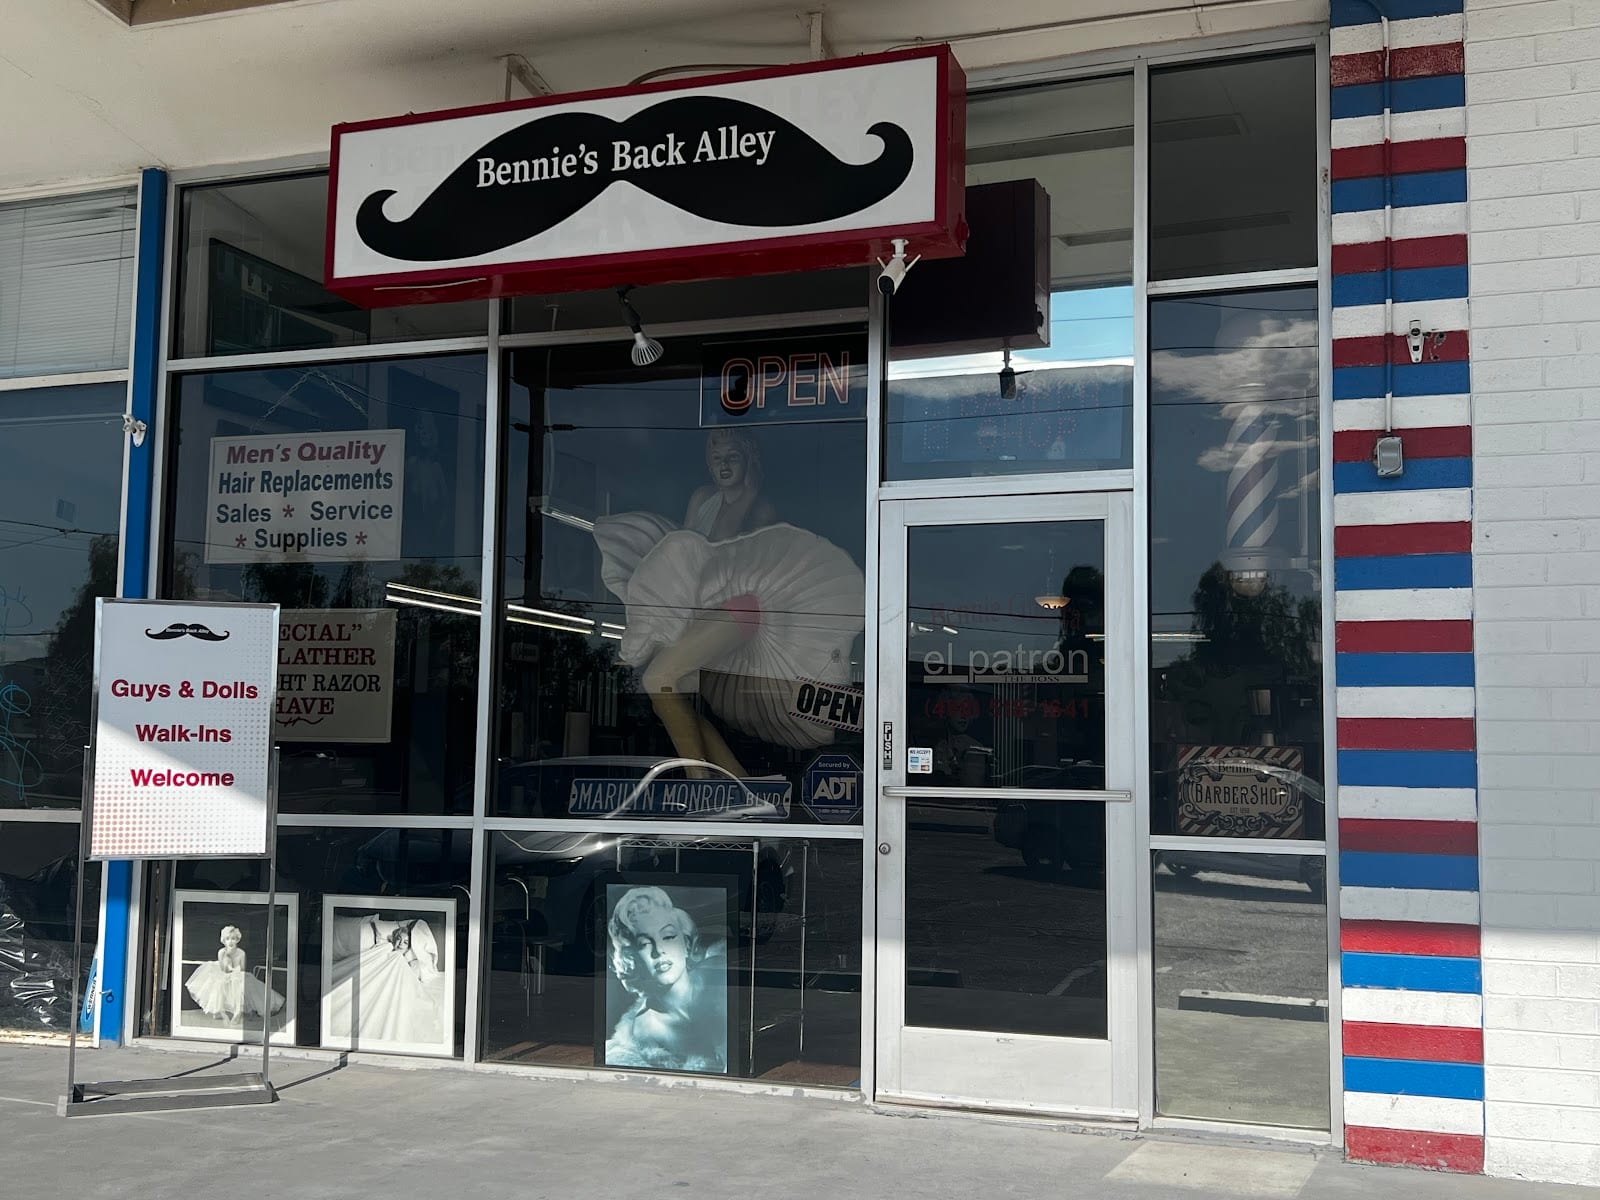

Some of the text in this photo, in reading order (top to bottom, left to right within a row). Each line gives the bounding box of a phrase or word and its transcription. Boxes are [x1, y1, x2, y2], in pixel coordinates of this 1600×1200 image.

[476, 143, 599, 189] Bennie's
[611, 132, 686, 173] Back
[693, 124, 776, 166] Alley
[720, 351, 850, 410] OPEN
[226, 440, 387, 465] Men's Quality
[218, 467, 394, 498] Hair Replacements
[216, 500, 393, 524] Sales Service
[254, 527, 348, 552] Supplies
[923, 642, 953, 675] el
[111, 679, 259, 702] Guys & Dolls
[312, 673, 382, 692] RAZOR
[796, 683, 863, 726] OPEN
[135, 724, 232, 743] Walk-Ins
[884, 724, 892, 759] PUSH
[842, 761, 851, 769] by
[130, 769, 235, 788] Welcome
[813, 776, 857, 801] ADT
[578, 782, 780, 813] MARILYN MONROE BLVD
